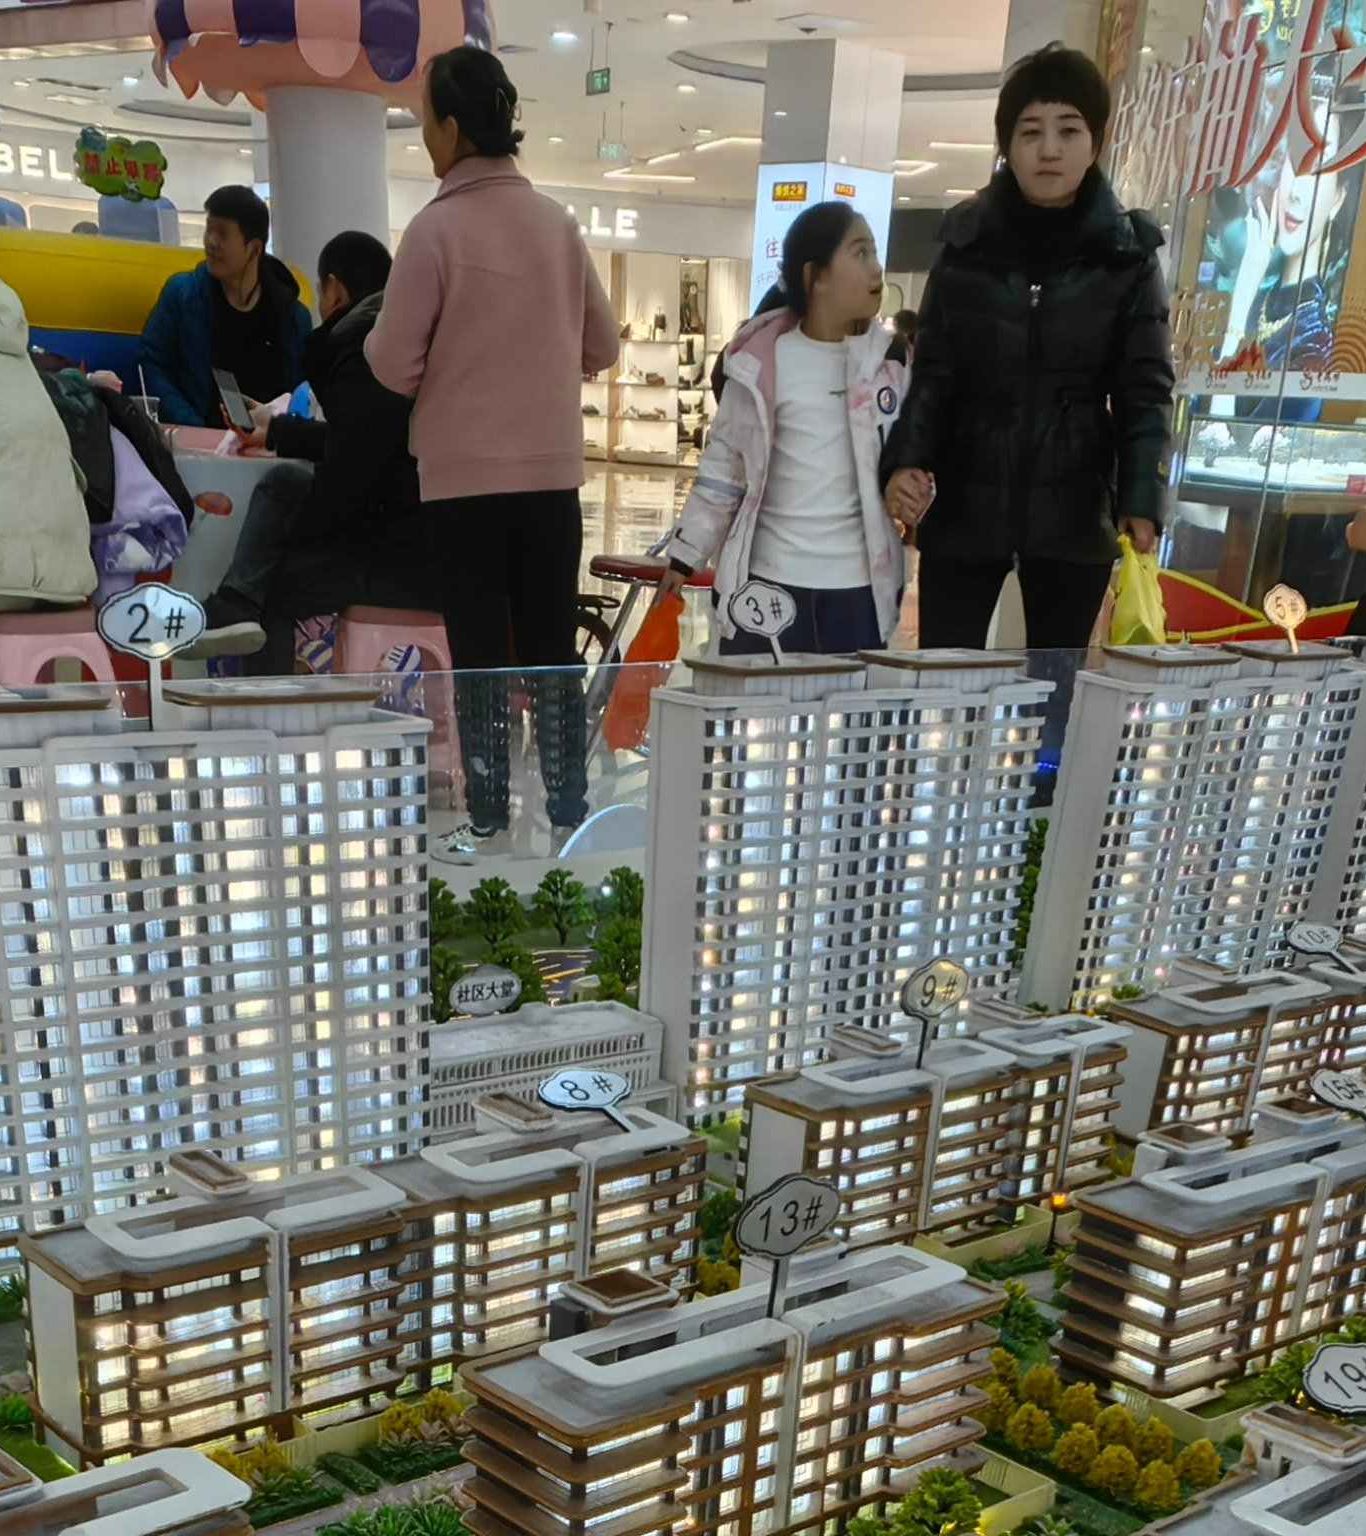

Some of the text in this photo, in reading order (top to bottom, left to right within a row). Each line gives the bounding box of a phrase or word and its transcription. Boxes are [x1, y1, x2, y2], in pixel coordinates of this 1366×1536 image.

[567, 205, 639, 238] LE
[127, 602, 186, 643] 2#
[745, 596, 783, 626] 3#
[1275, 596, 1298, 619] 5#
[457, 980, 515, 1004] 社区大堂
[920, 974, 957, 1007] 9#
[559, 1074, 613, 1101] 8#
[1322, 1075, 1365, 1101] 15#
[759, 1195, 823, 1243] 13#
